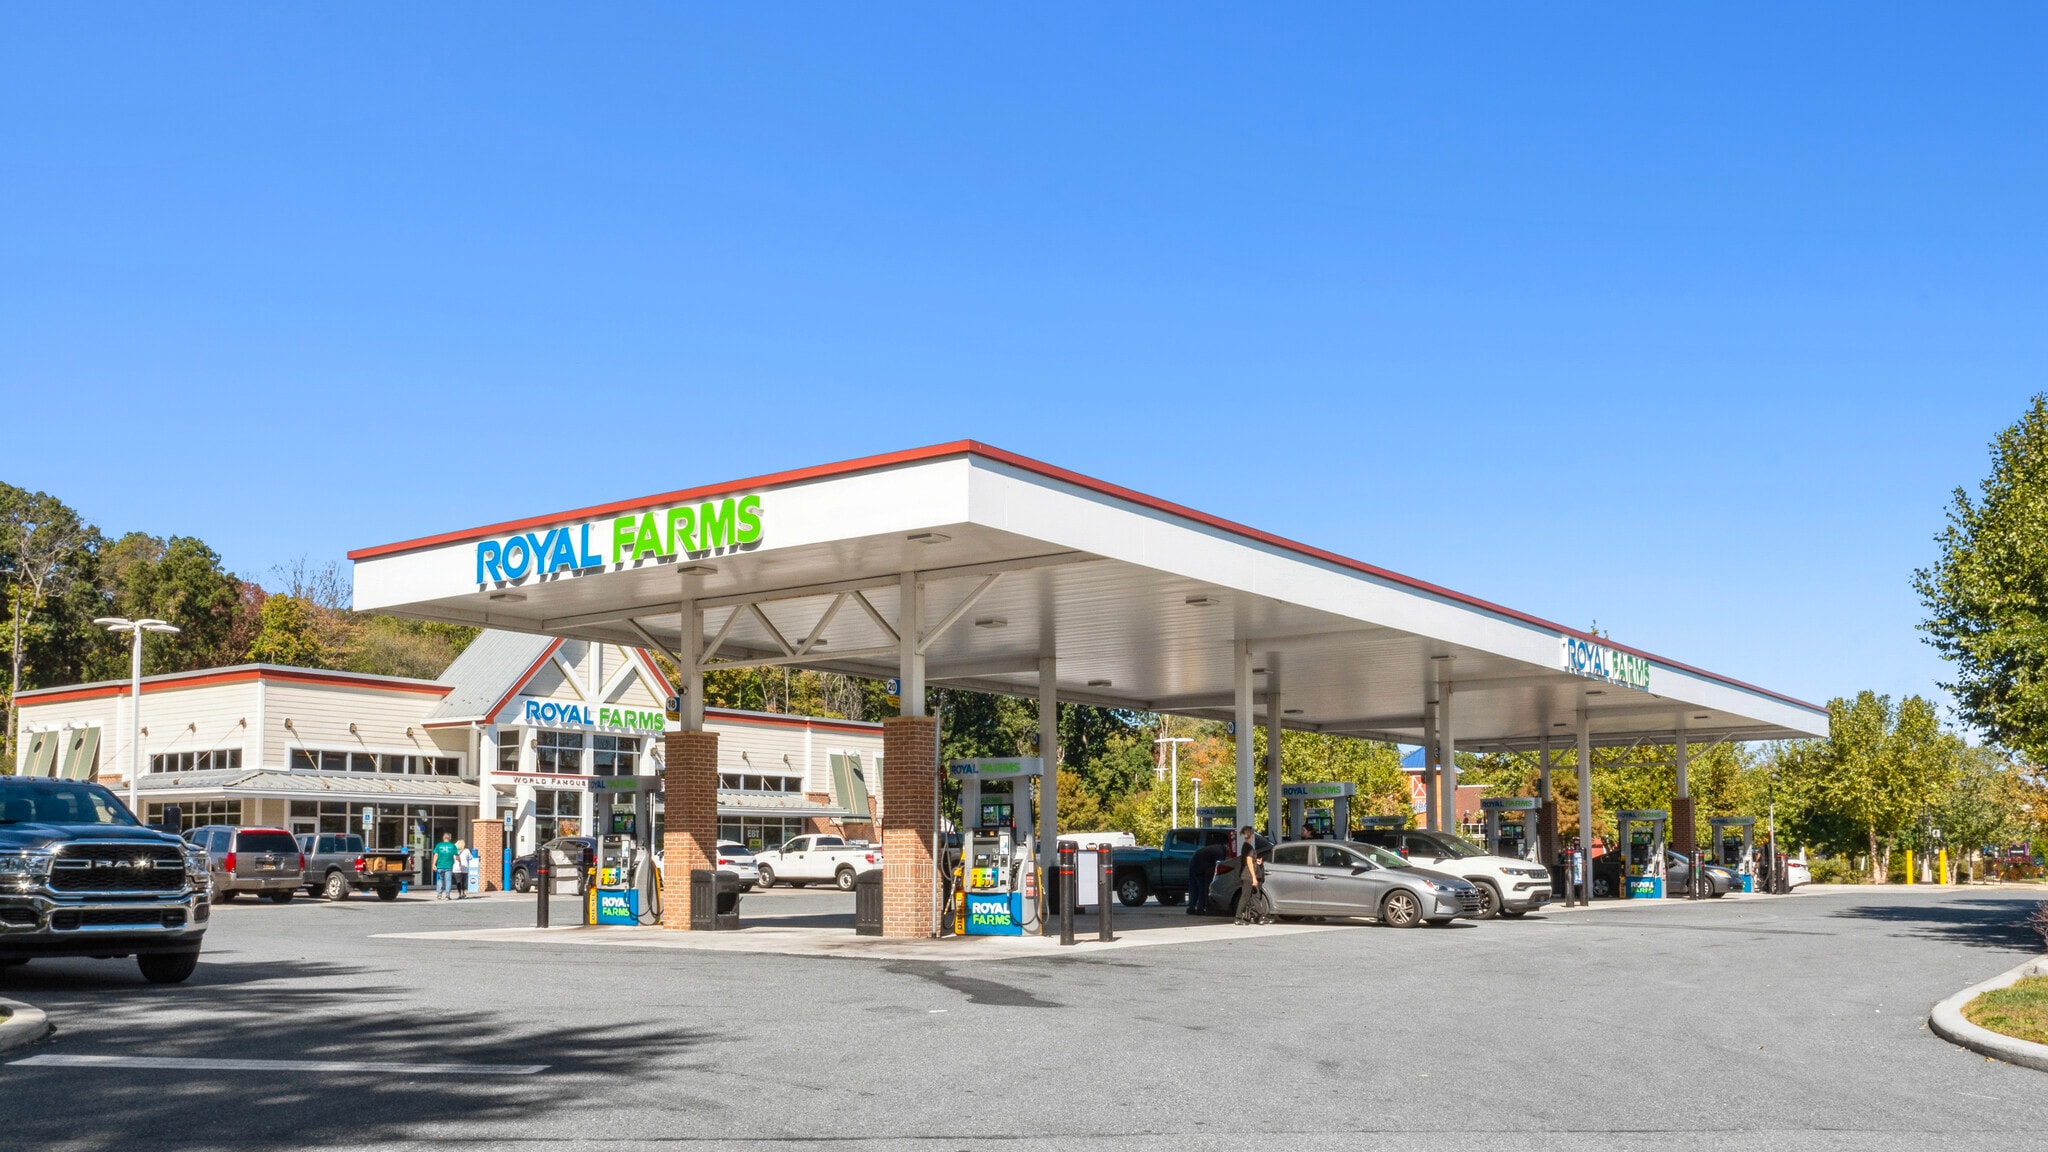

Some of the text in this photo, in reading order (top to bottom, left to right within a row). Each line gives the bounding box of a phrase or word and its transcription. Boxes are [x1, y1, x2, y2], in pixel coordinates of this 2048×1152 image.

[476, 495, 762, 584] ROYAL FARMS
[1568, 638, 1650, 688] ROYAL FARMS
[888, 681, 896, 692] 20
[667, 699, 676, 709] 18
[525, 700, 664, 731] ROYAL FARMS
[951, 762, 1021, 775] ROYAL FARMS
[513, 776, 587, 787] WORLD FAMOUS
[590, 779, 606, 789] OYAL
[1283, 785, 1342, 795] ROYAL FARMS
[1505, 799, 1533, 807] FARMS
[747, 829, 760, 839] EBT
[602, 907, 630, 917] FARMS
[972, 902, 1011, 914] ROYAL
[972, 914, 1011, 926] FARMS
